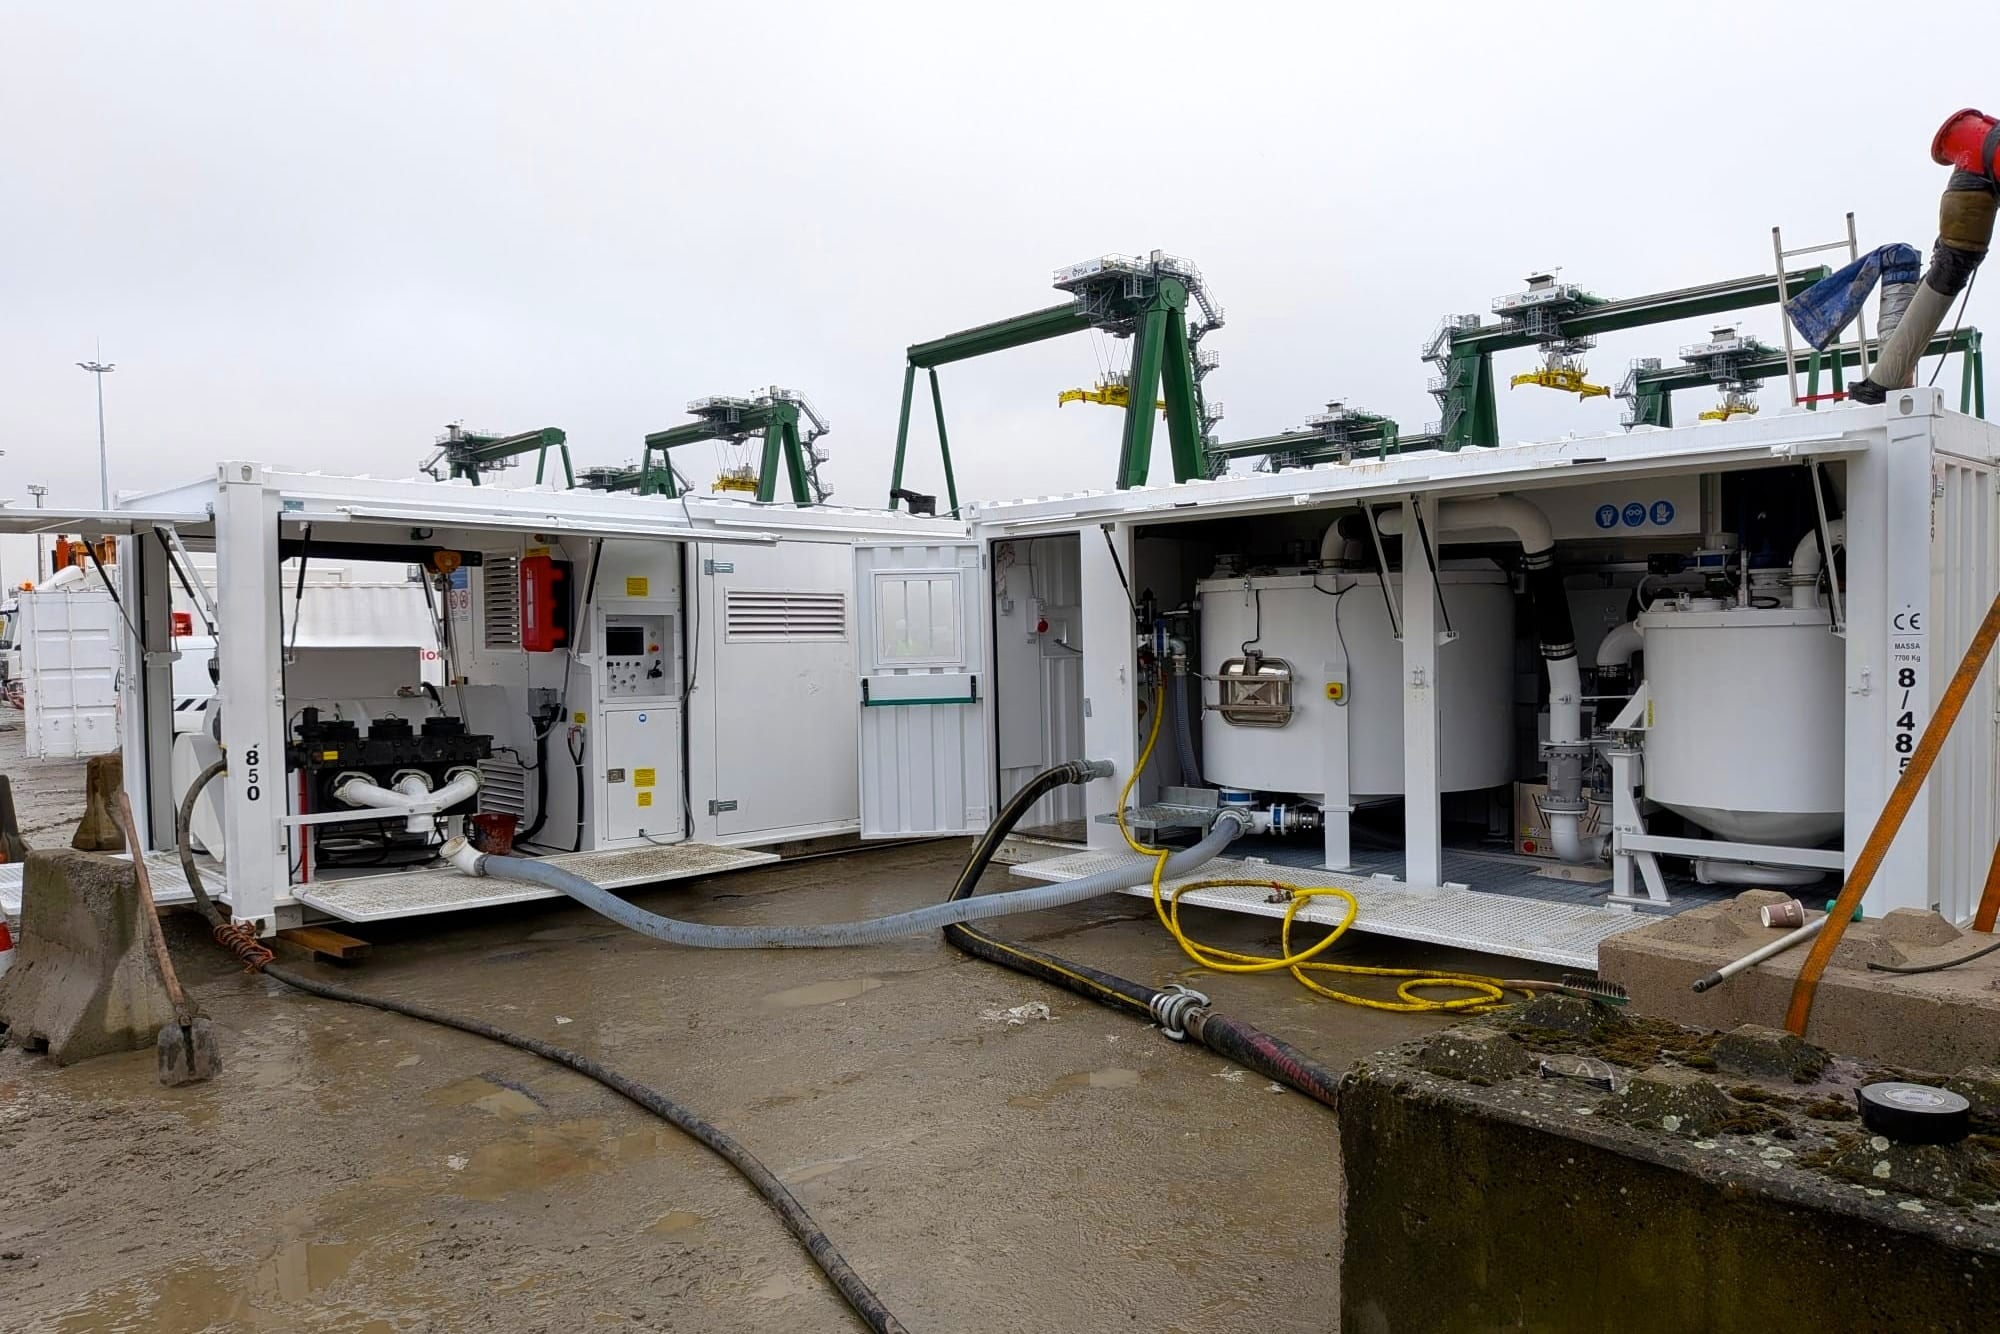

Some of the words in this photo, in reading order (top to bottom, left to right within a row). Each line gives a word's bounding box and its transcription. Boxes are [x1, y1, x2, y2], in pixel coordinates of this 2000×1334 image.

[1893, 612, 1921, 631] CE
[1894, 642, 1921, 650] MASSA
[1911, 654, 1921, 663] Kg
[245, 750, 261, 801] 850
